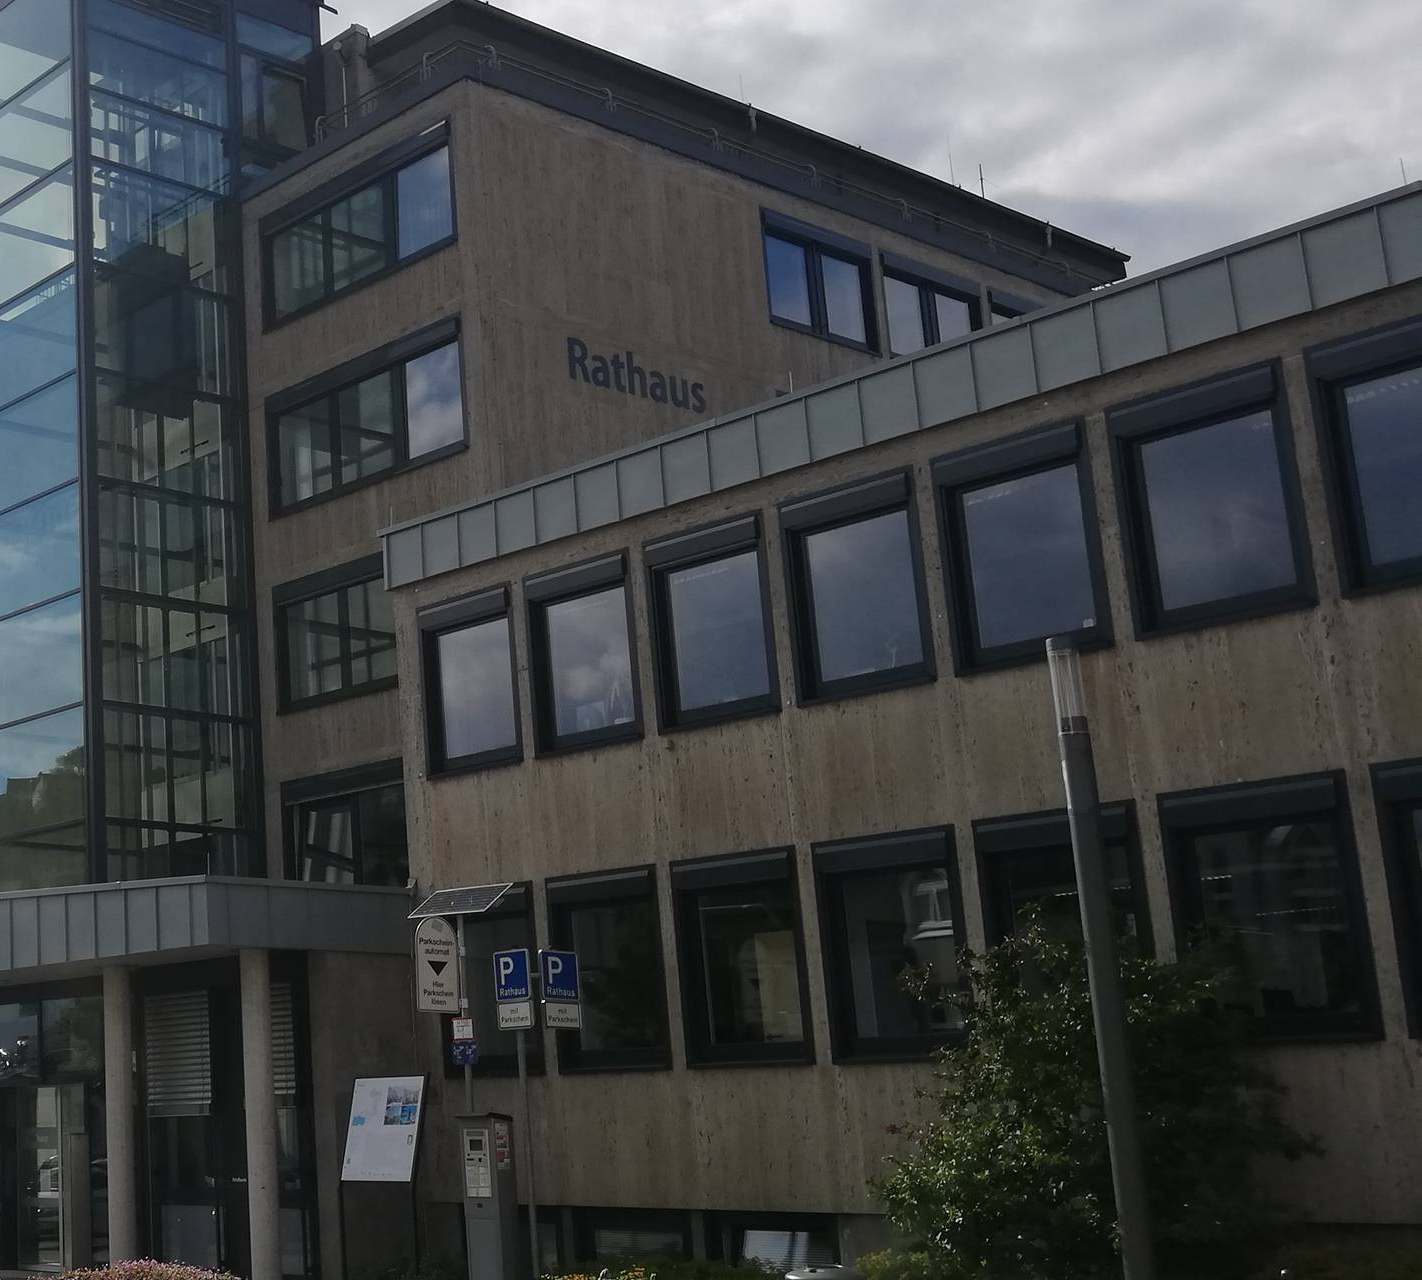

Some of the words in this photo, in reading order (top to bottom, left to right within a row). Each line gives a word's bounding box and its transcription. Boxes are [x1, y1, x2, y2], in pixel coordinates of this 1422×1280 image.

[567, 336, 707, 414] Rathaus
[424, 948, 450, 956] automat
[499, 956, 514, 986] P
[547, 956, 563, 985] P
[432, 980, 444, 988] Hier
[423, 988, 454, 998] Parkschein
[499, 987, 526, 997] Rathaus
[546, 986, 576, 997] Rathaus
[431, 998, 447, 1006] lösen
